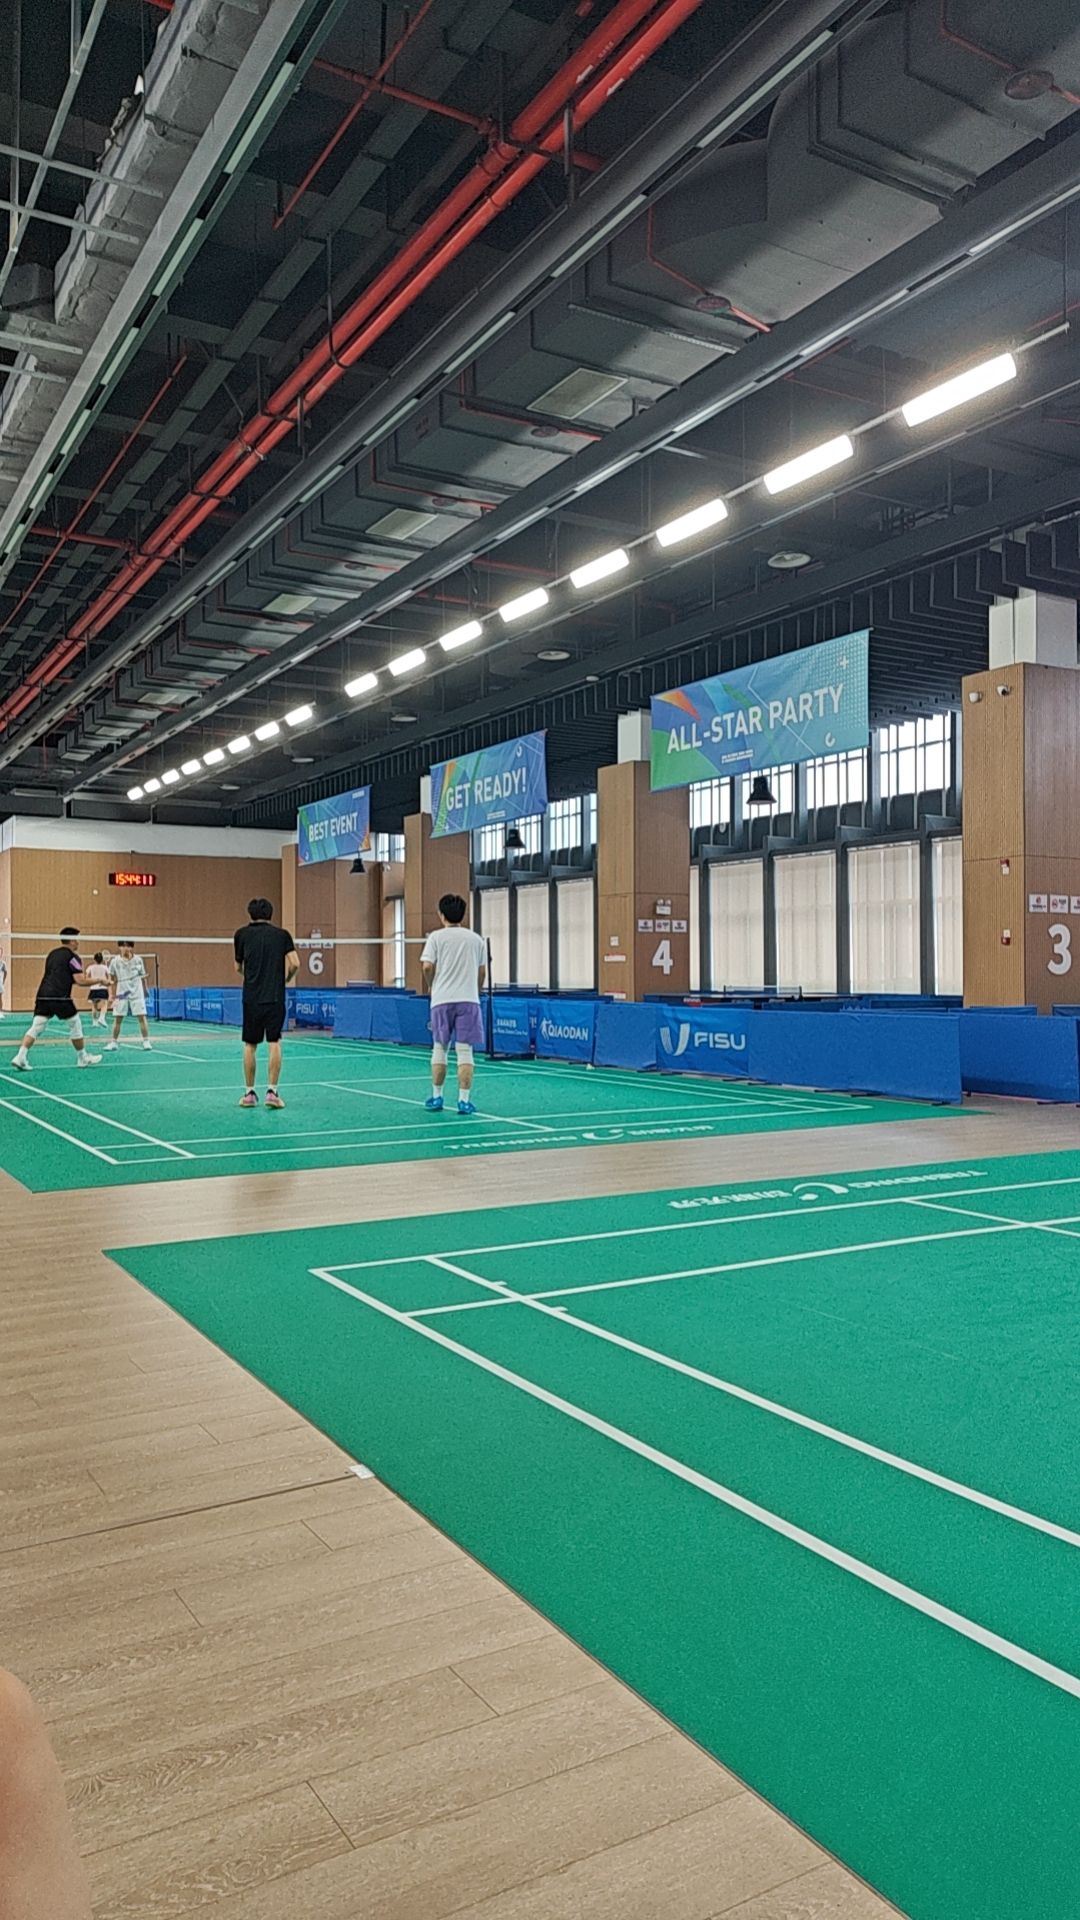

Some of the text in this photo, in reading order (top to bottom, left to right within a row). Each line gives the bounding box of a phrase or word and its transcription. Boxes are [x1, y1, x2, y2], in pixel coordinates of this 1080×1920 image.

[667, 683, 843, 754] ALL-STAR PARTY
[446, 767, 526, 811] GET READY!
[309, 812, 358, 842] BEST EVENT
[309, 952, 323, 975] 6
[652, 939, 673, 975] 4
[1047, 923, 1072, 975] 3
[548, 1024, 588, 1041] QIAODAN
[694, 1031, 745, 1051] FISU
